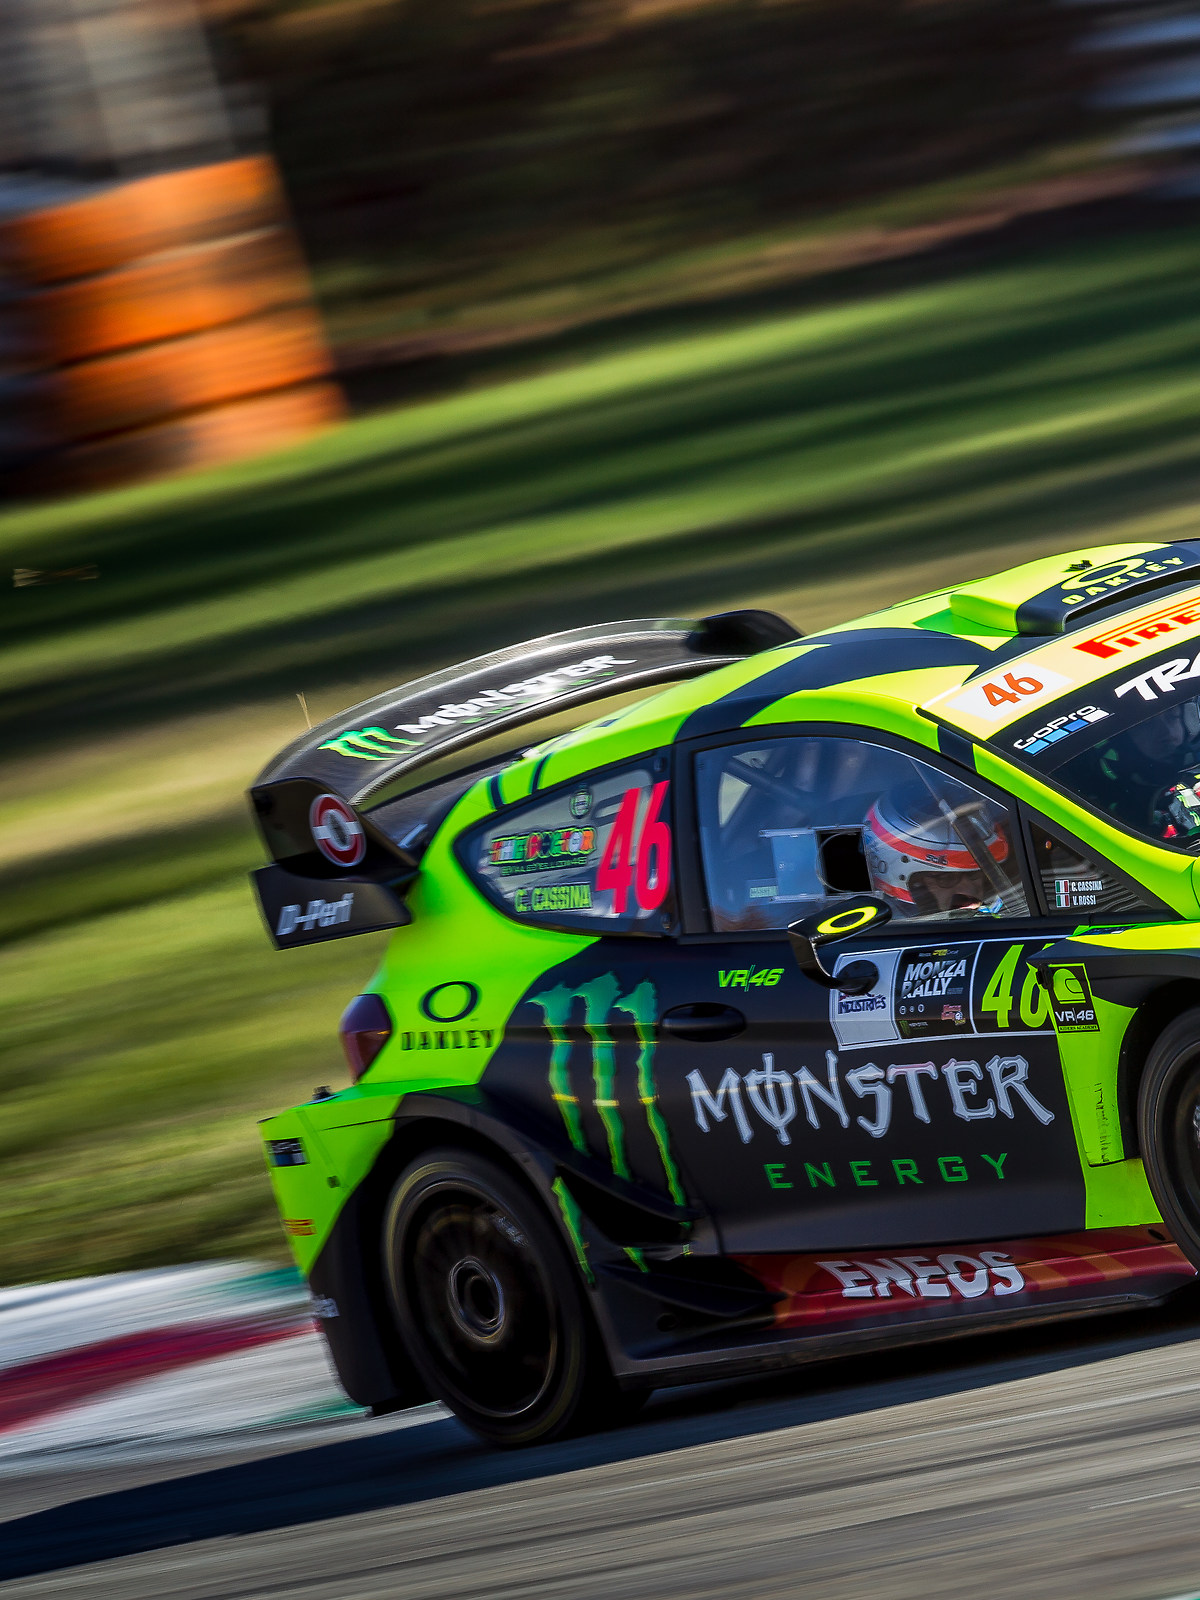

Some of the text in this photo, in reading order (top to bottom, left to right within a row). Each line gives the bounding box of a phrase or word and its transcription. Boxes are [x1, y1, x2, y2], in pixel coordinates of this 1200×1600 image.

[1061, 556, 1185, 605] OAKLEY
[394, 655, 638, 734] MONSTER
[981, 672, 1044, 707] 46
[1012, 704, 1098, 750] GoPro
[595, 780, 672, 913] 46
[531, 883, 593, 912] CASSINA
[1072, 894, 1096, 906] V. ROSSI
[1077, 880, 1103, 891] CASSINA
[904, 959, 967, 981] MONZA
[901, 977, 952, 1000] RALLY
[401, 1029, 494, 1051] OAKLEY
[684, 1050, 1055, 1146] MONSTER
[763, 1152, 1009, 1189] ENERGY
[816, 1250, 1026, 1300] ENEOS
